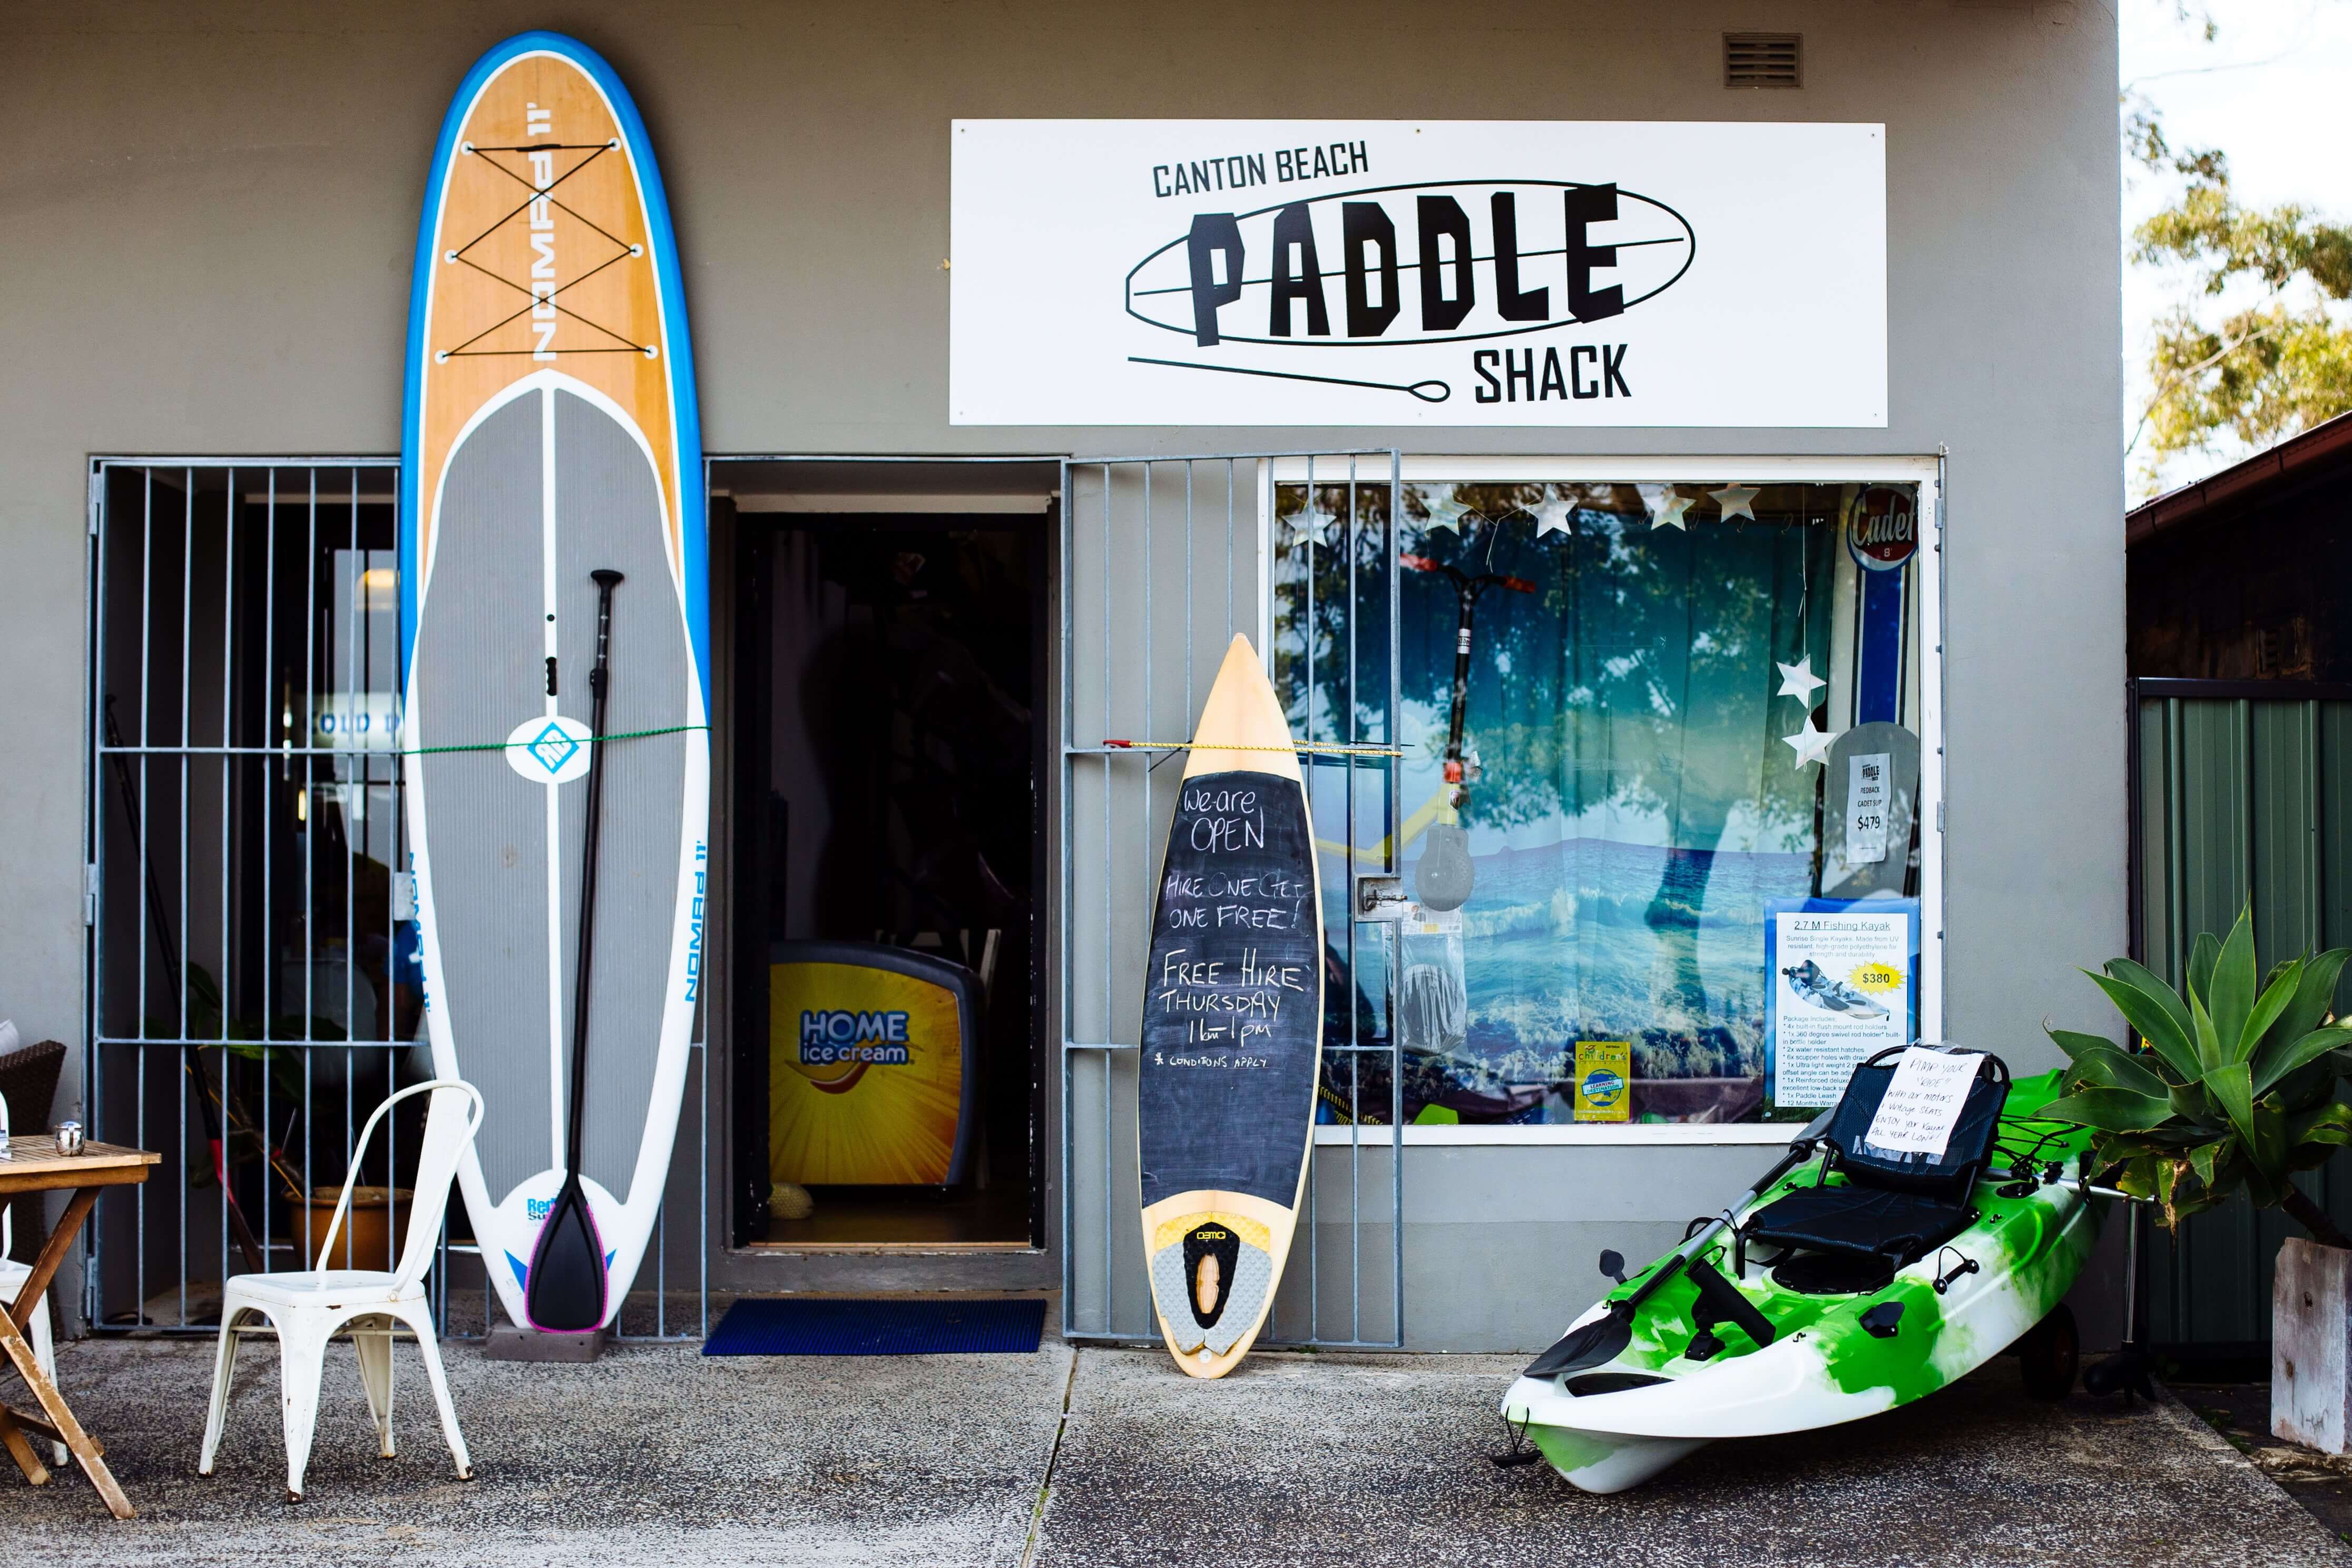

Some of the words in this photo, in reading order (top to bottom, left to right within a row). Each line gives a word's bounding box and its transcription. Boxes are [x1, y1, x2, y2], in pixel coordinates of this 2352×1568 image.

[1153, 153, 1267, 198] CANTON
[1276, 140, 1369, 183] BEACH
[1187, 182, 1624, 347] PADDLE
[1473, 344, 1632, 404] SHACK
[1853, 493, 1916, 546] Cadet
[1862, 765, 1880, 778] PADDLE
[1216, 790, 1257, 814] are
[1191, 807, 1265, 853] OPEN
[1858, 815, 1880, 831] $479
[1165, 874, 1204, 900] HIRE
[1208, 872, 1259, 897] ONE
[1169, 907, 1208, 928] ONE
[1217, 899, 1301, 929] FREE!
[1795, 921, 1809, 930] 2.7
[1812, 921, 1820, 929] M
[1824, 921, 1858, 931] Fishing
[1861, 921, 1890, 932] Kayak
[1164, 948, 1223, 987] FREE
[1240, 947, 1304, 991] HIRE
[1863, 973, 1890, 984] $380
[1159, 988, 1280, 1022] THURSDAY
[803, 1013, 906, 1041] HOME
[803, 1043, 834, 1062] ice
[838, 1046, 906, 1062] cream
[1170, 1055, 1227, 1068] CONDITIONS
[1234, 1056, 1267, 1069] APPLY
[1910, 1057, 1939, 1073] PIMP
[1942, 1062, 1968, 1075] YOUR
[1586, 1084, 1619, 1093] DESTINATION
[1590, 1081, 1614, 1089] LEARNING
[1924, 1092, 1954, 1103] motors
[1919, 1106, 1943, 1116] SEATS
[1889, 1130, 1909, 1139] YEAR
